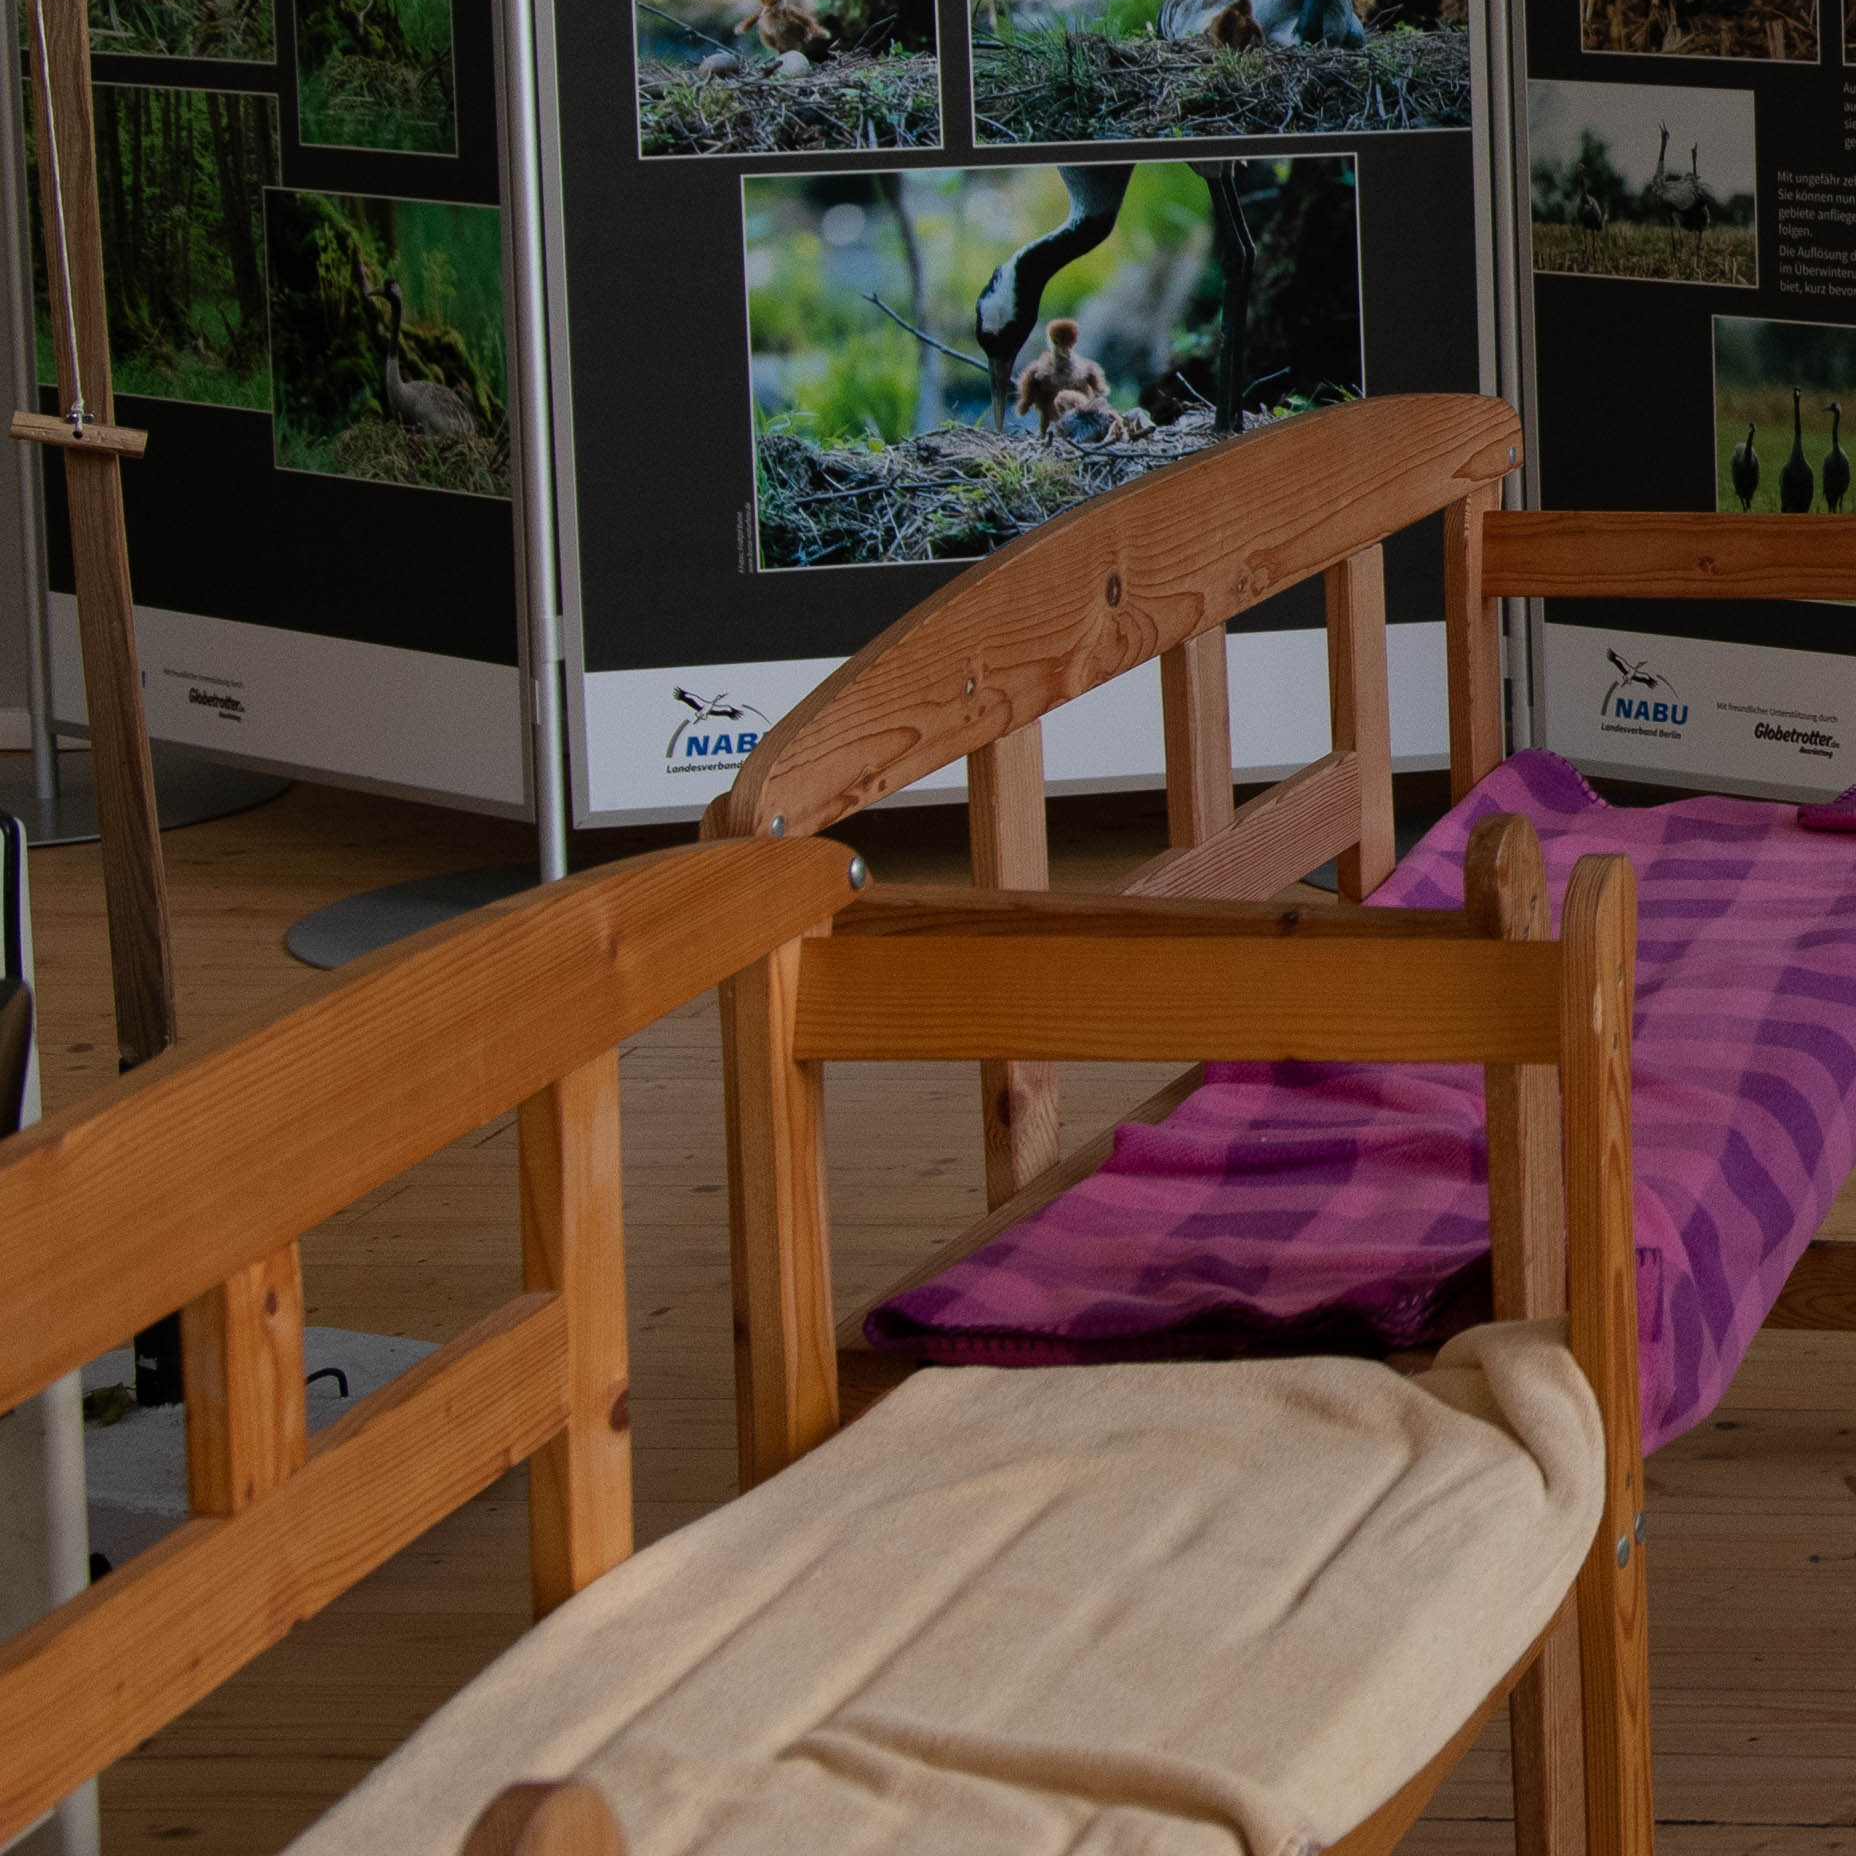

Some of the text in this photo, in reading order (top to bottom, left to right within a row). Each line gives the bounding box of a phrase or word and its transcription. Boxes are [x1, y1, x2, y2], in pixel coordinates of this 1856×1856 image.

[1615, 697, 1689, 725] NABU
[1601, 722, 1682, 740] Landesverband Berlin
[686, 732, 768, 757] NAB
